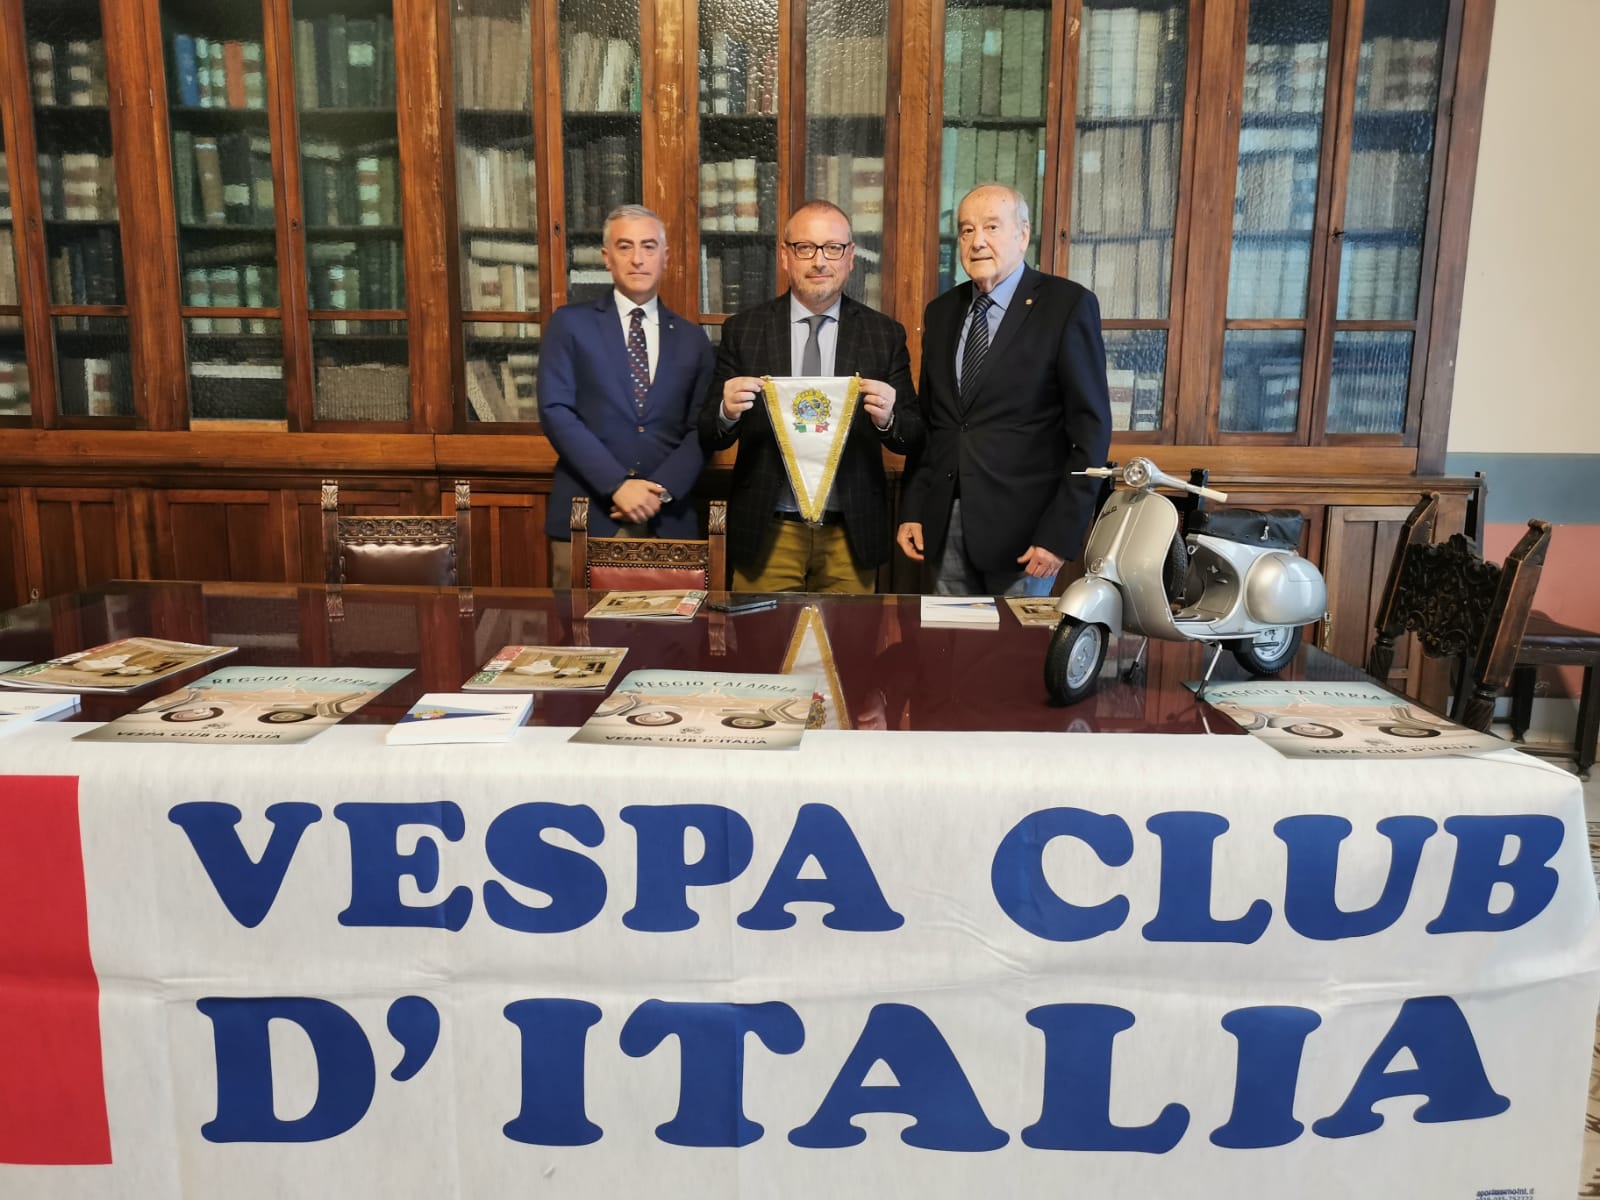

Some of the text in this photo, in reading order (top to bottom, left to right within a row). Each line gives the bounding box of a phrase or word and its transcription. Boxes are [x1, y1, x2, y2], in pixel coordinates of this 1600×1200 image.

[212, 675, 379, 687] REGGIO CALABRIA
[634, 680, 798, 693] REGGIO CALABRIA
[1211, 688, 1382, 701] REGGIO CALABRIA
[1366, 747, 1407, 755] CLUB
[169, 803, 1565, 943] VESPA CLUB
